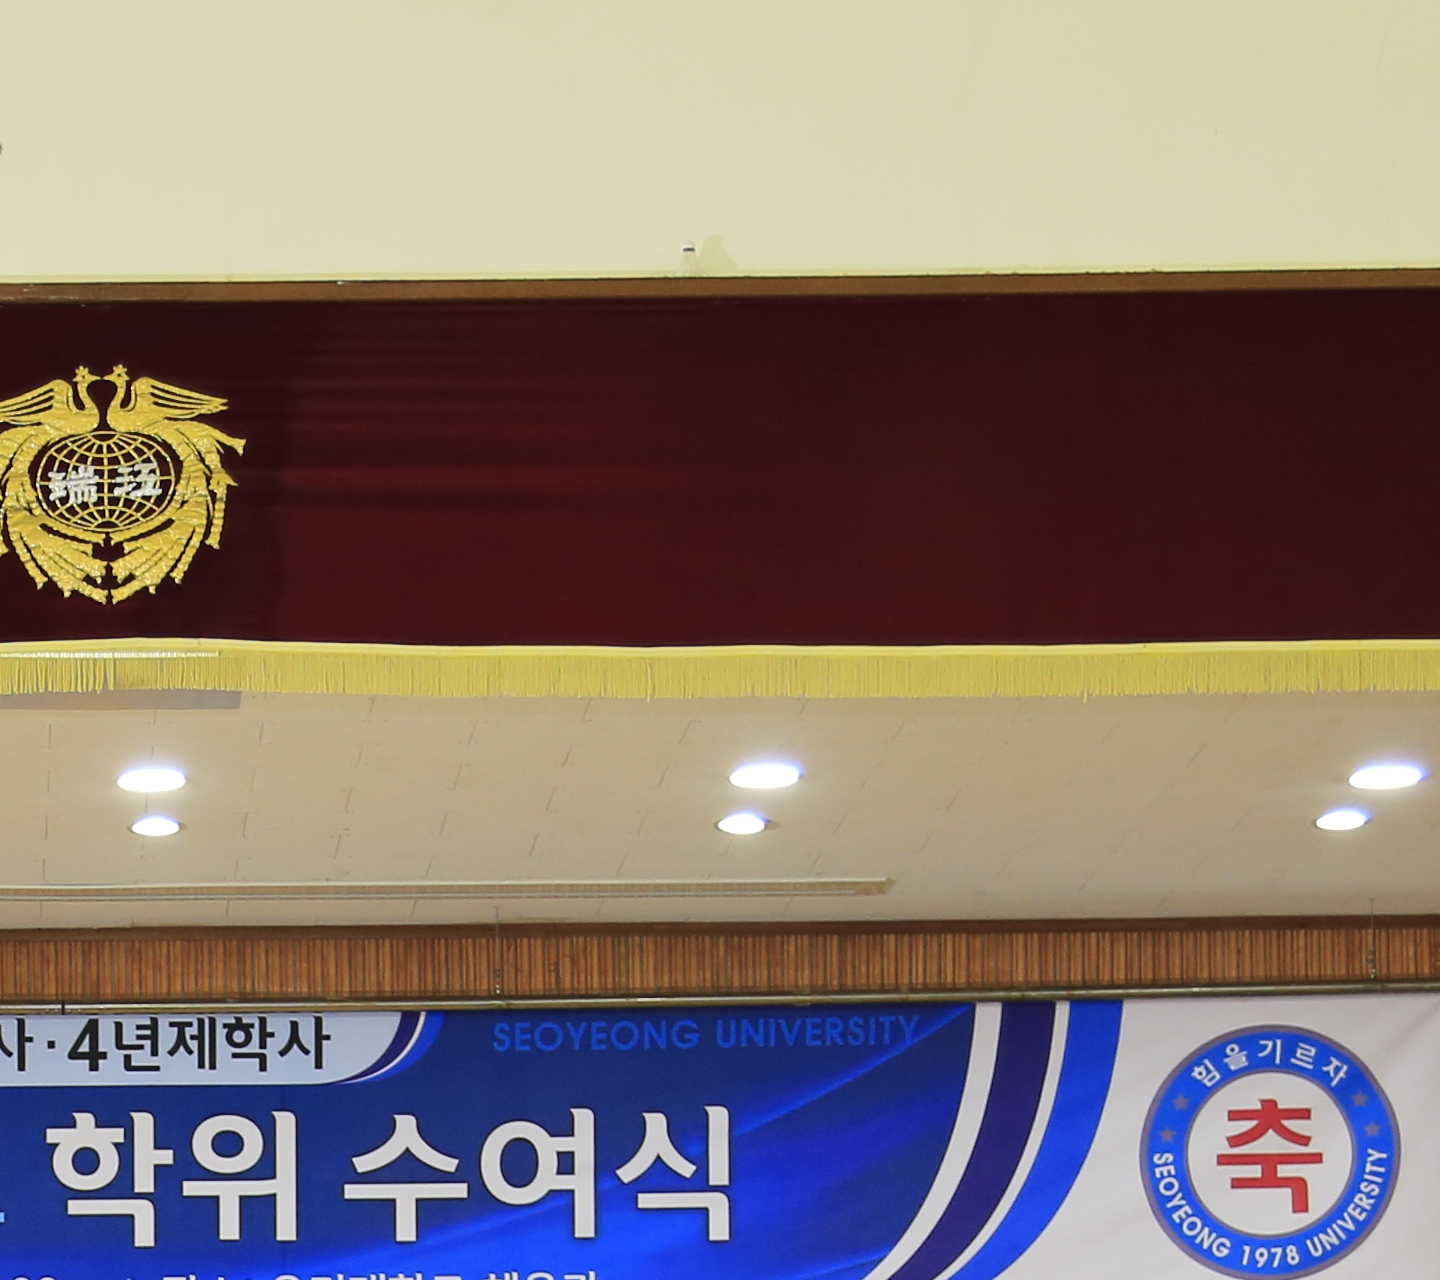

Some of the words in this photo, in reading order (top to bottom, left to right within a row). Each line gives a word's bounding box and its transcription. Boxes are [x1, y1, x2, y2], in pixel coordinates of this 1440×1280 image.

[492, 1019, 701, 1052] SEOYEONG
[717, 1014, 920, 1048] UNIVERSITY
[45, 1110, 298, 1248] 학위
[342, 1105, 732, 1243] 수여식
[1152, 1151, 1232, 1259] SEOYEONG
[1241, 1244, 1301, 1269] 1978
[1305, 1148, 1388, 1258] UNIVERSITY
[1216, 1098, 1324, 1215] 축
